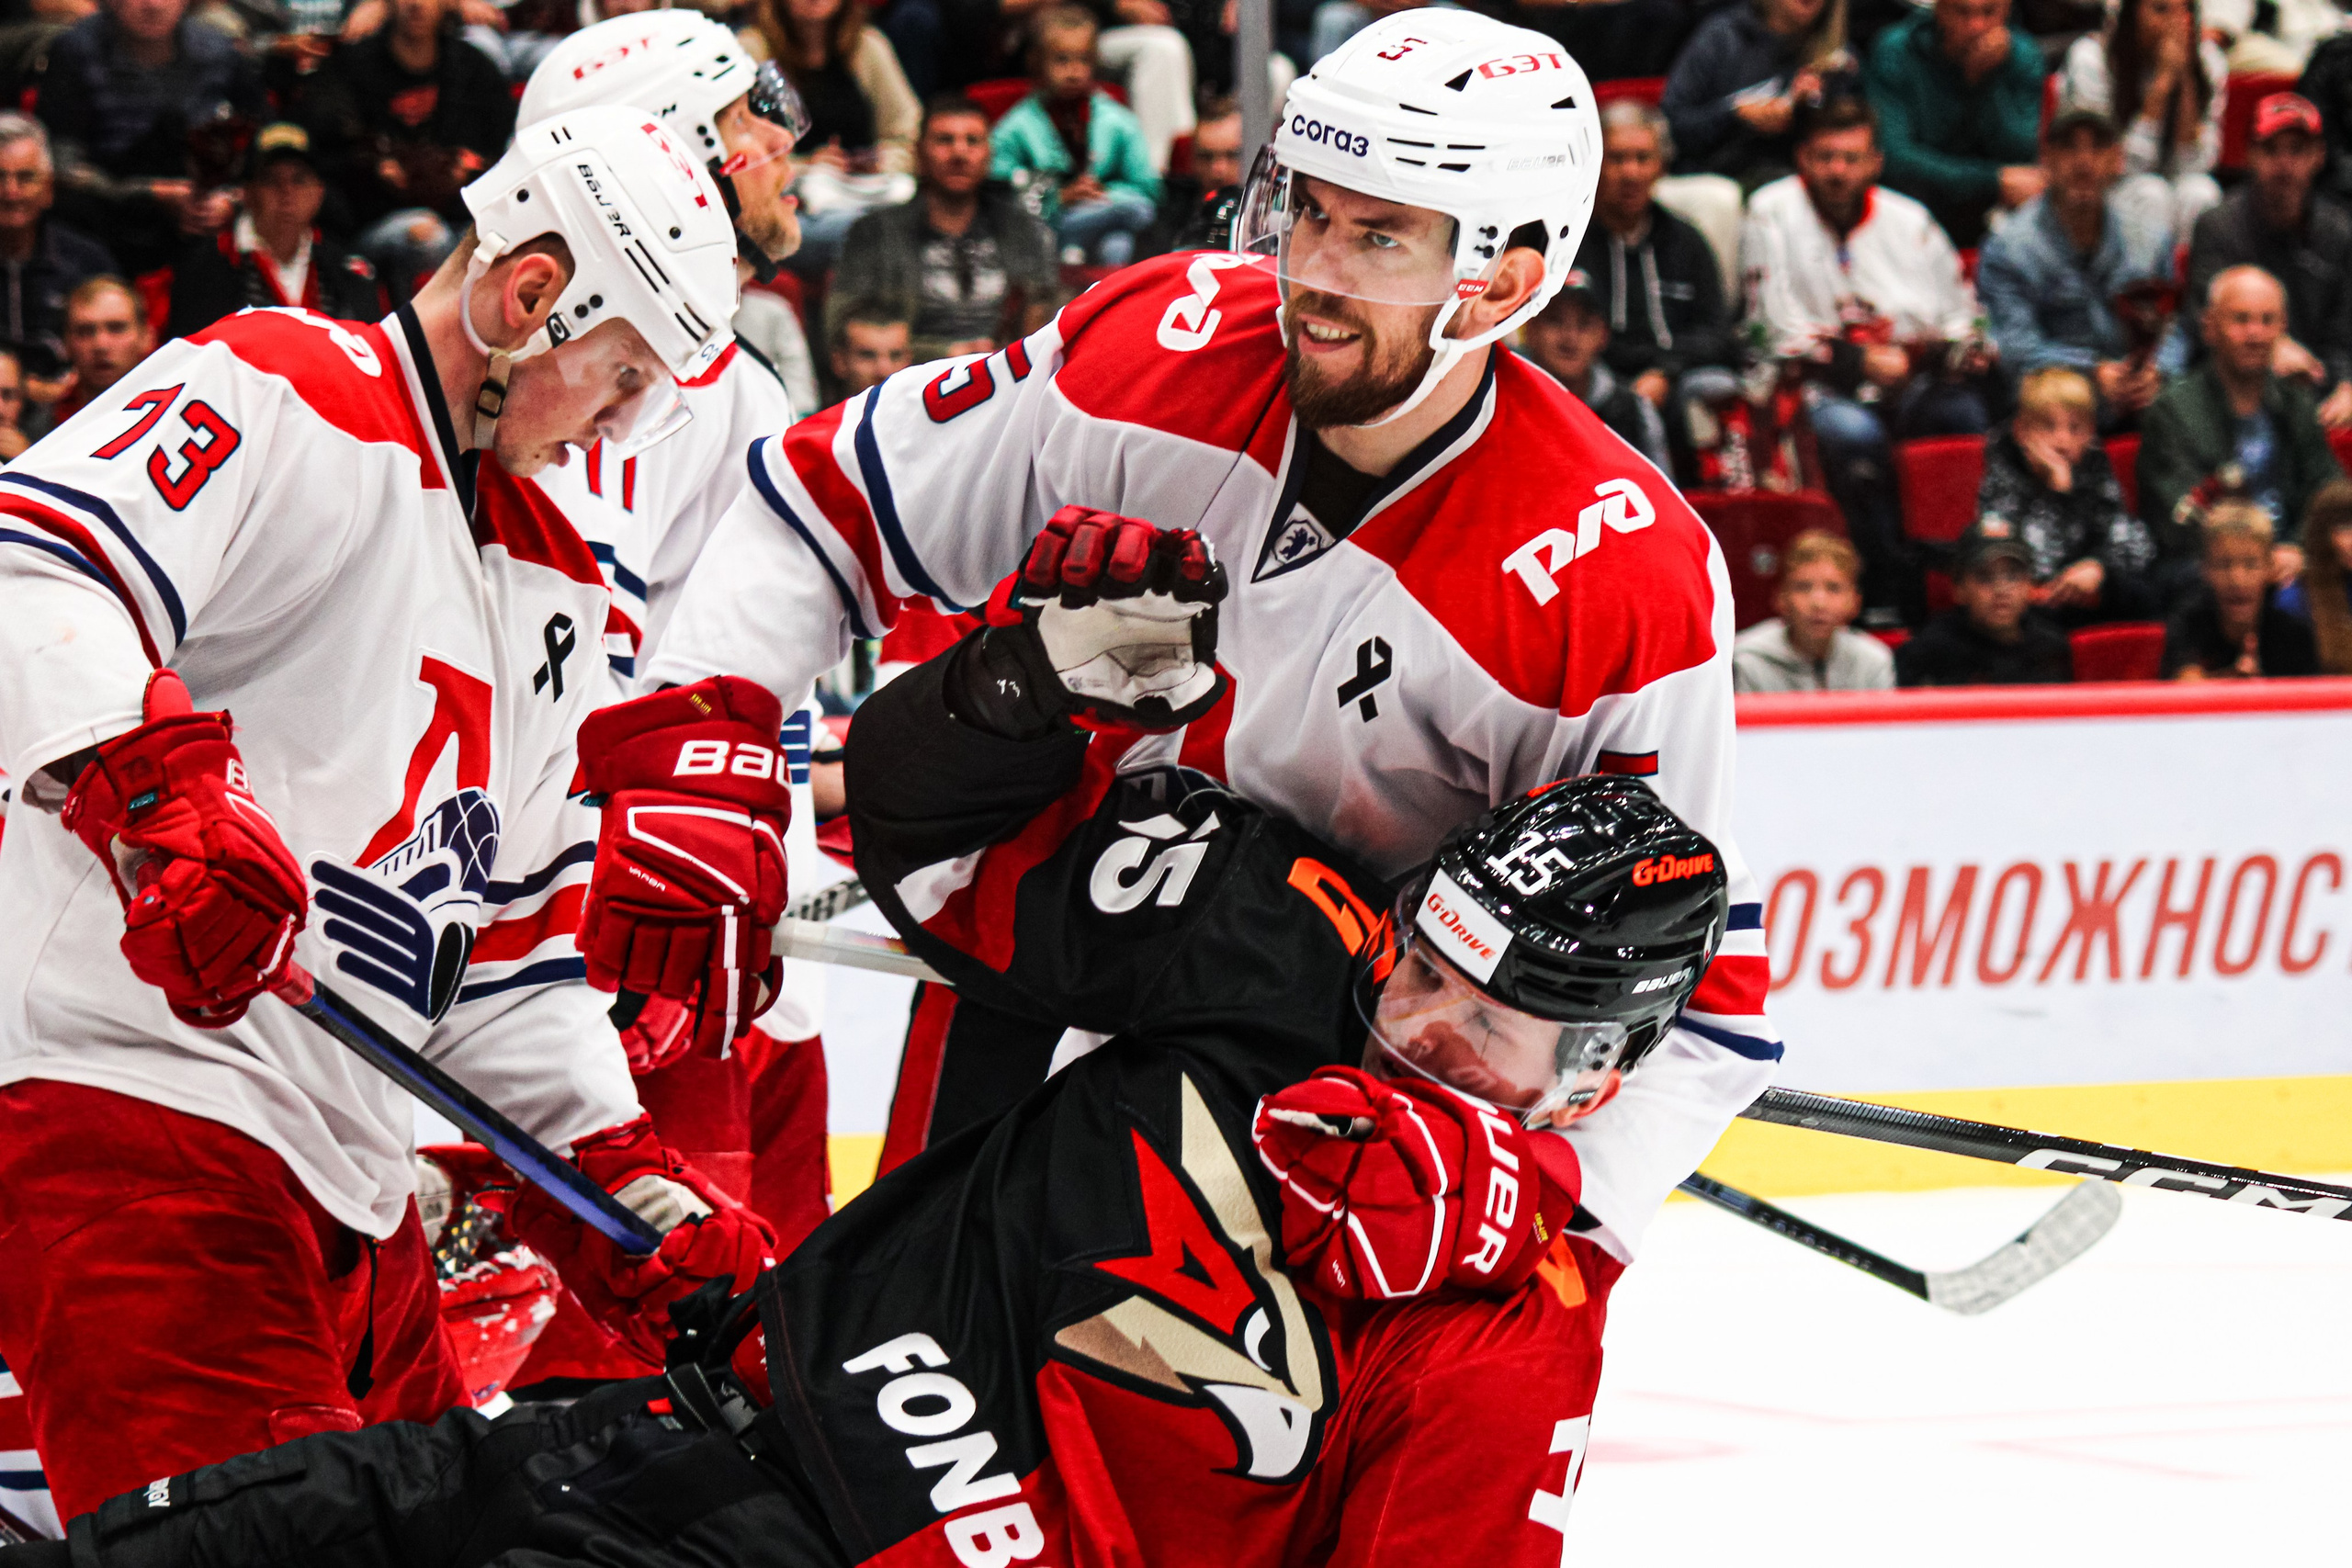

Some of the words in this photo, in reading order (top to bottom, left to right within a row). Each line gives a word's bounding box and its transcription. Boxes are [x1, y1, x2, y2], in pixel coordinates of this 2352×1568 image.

[89, 381, 242, 513] 73
[1487, 829, 1577, 897] 15
[842, 1331, 1046, 1568] FONB
